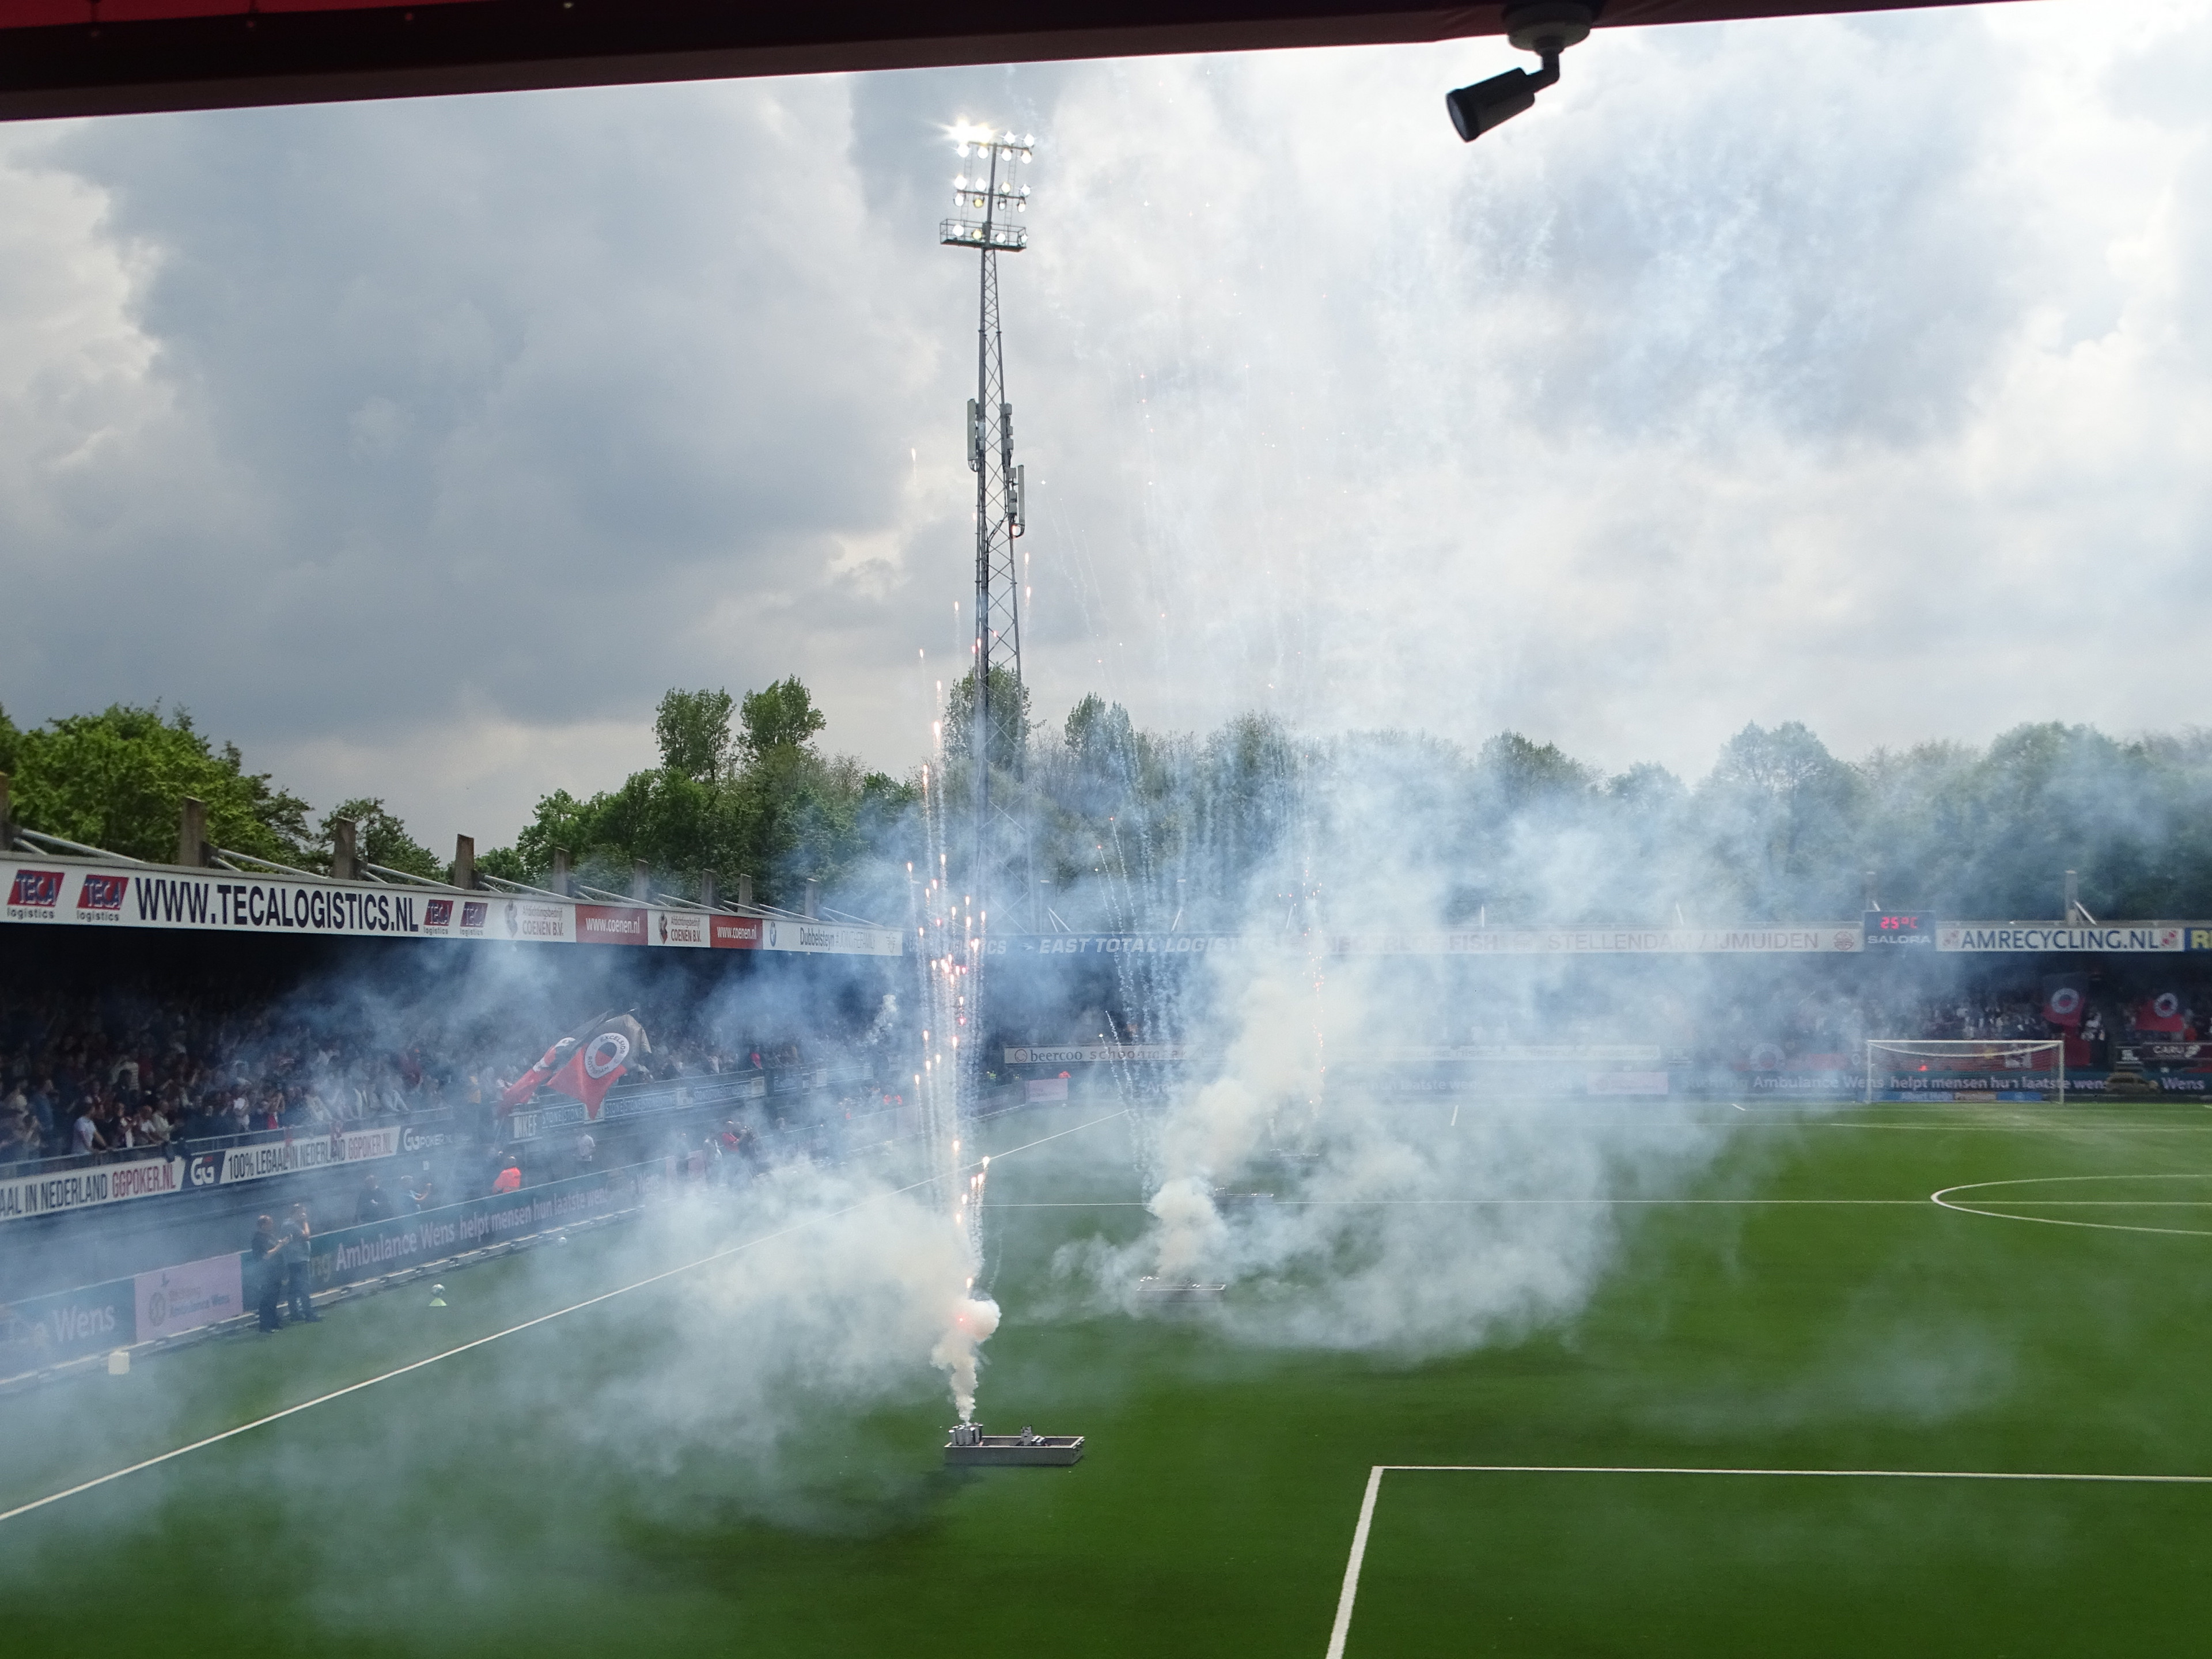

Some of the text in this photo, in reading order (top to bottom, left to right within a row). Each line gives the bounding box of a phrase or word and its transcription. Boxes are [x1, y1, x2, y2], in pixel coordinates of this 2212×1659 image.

[15, 872, 56, 905] TECA
[84, 877, 121, 908] TECA
[7, 907, 55, 919] logistics
[135, 877, 419, 932] WWW.TECALOGISTICS.NL
[76, 910, 120, 922] logistics
[585, 916, 640, 934] www.coenen.nl
[423, 926, 449, 935] logistics
[522, 919, 565, 936] COENEN B.V.
[671, 929, 702, 942] COENEN B.V.
[717, 924, 757, 940] www.coenen.nl
[800, 927, 835, 950] Dubbelsteyn
[1040, 938, 1090, 955] EAST
[1096, 937, 1156, 953] TOTAL
[1449, 934, 1498, 950] FISH
[1547, 933, 1692, 950] STELLENDAM
[1714, 932, 1819, 950] IJMUIDEN
[1868, 935, 1931, 944] SALORA
[1960, 930, 2160, 949] AMRECYCLING.NL
[2190, 930, 2212, 949] R
[1030, 1049, 1083, 1061] beercoo
[1753, 1075, 1839, 1088] Ambulance
[1844, 1075, 1884, 1088] Wens
[1890, 1075, 1927, 1090] helpt
[1931, 1078, 1988, 1089] mensen
[2161, 1077, 2205, 1090] Wens
[228, 1152, 254, 1180] 100%
[256, 1147, 288, 1175] LEGAAL
[300, 1139, 345, 1168] NEDERLAND
[347, 1132, 393, 1161] GGPOKER.NL
[25, 1184, 37, 1213] IN
[40, 1173, 108, 1211] NEDERLAND
[112, 1162, 176, 1199] GGPOKER.NL
[336, 1231, 418, 1272] Ambulance
[420, 1221, 455, 1249] Wens
[460, 1211, 490, 1242] helpt
[491, 1206, 532, 1233] mensen
[533, 1196, 552, 1221] hun
[554, 1192, 586, 1216] laatste
[51, 1304, 115, 1343] Wens
